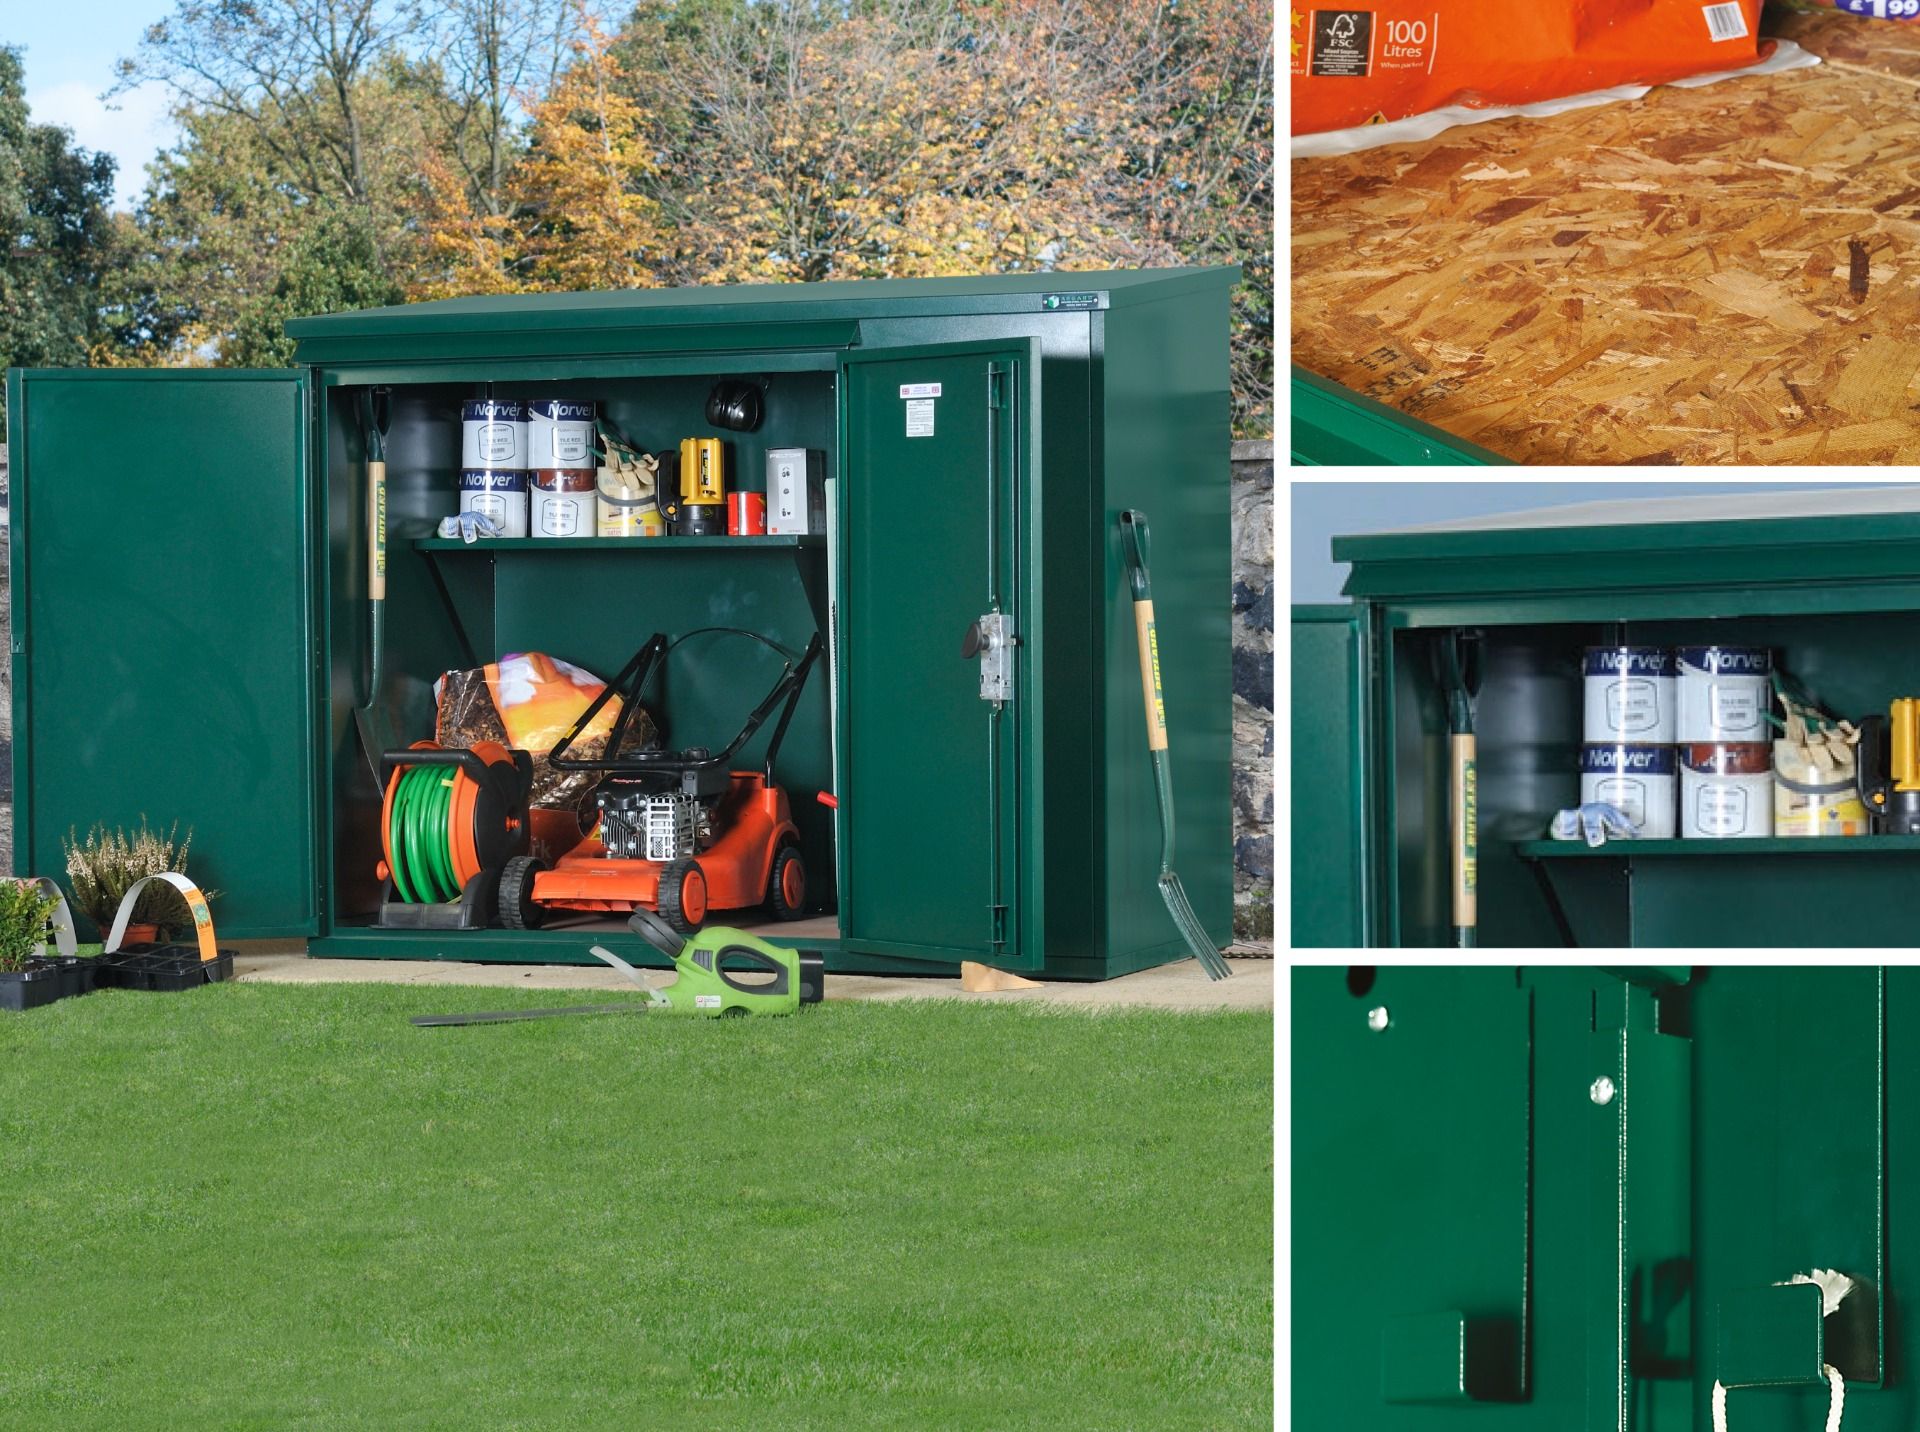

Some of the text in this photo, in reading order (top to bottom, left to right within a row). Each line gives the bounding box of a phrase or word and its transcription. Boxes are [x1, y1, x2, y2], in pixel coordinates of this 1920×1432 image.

[1386, 20, 1427, 44] 100
[1330, 39, 1353, 48] FSC
[1383, 44, 1422, 57] Litres
[1401, 61, 1424, 69] packed
[474, 403, 522, 416] Norver
[466, 473, 512, 487] Norver
[1150, 629, 1162, 690] RUTLAND
[1600, 652, 1666, 670] Norver
[1589, 750, 1654, 768] Norver
